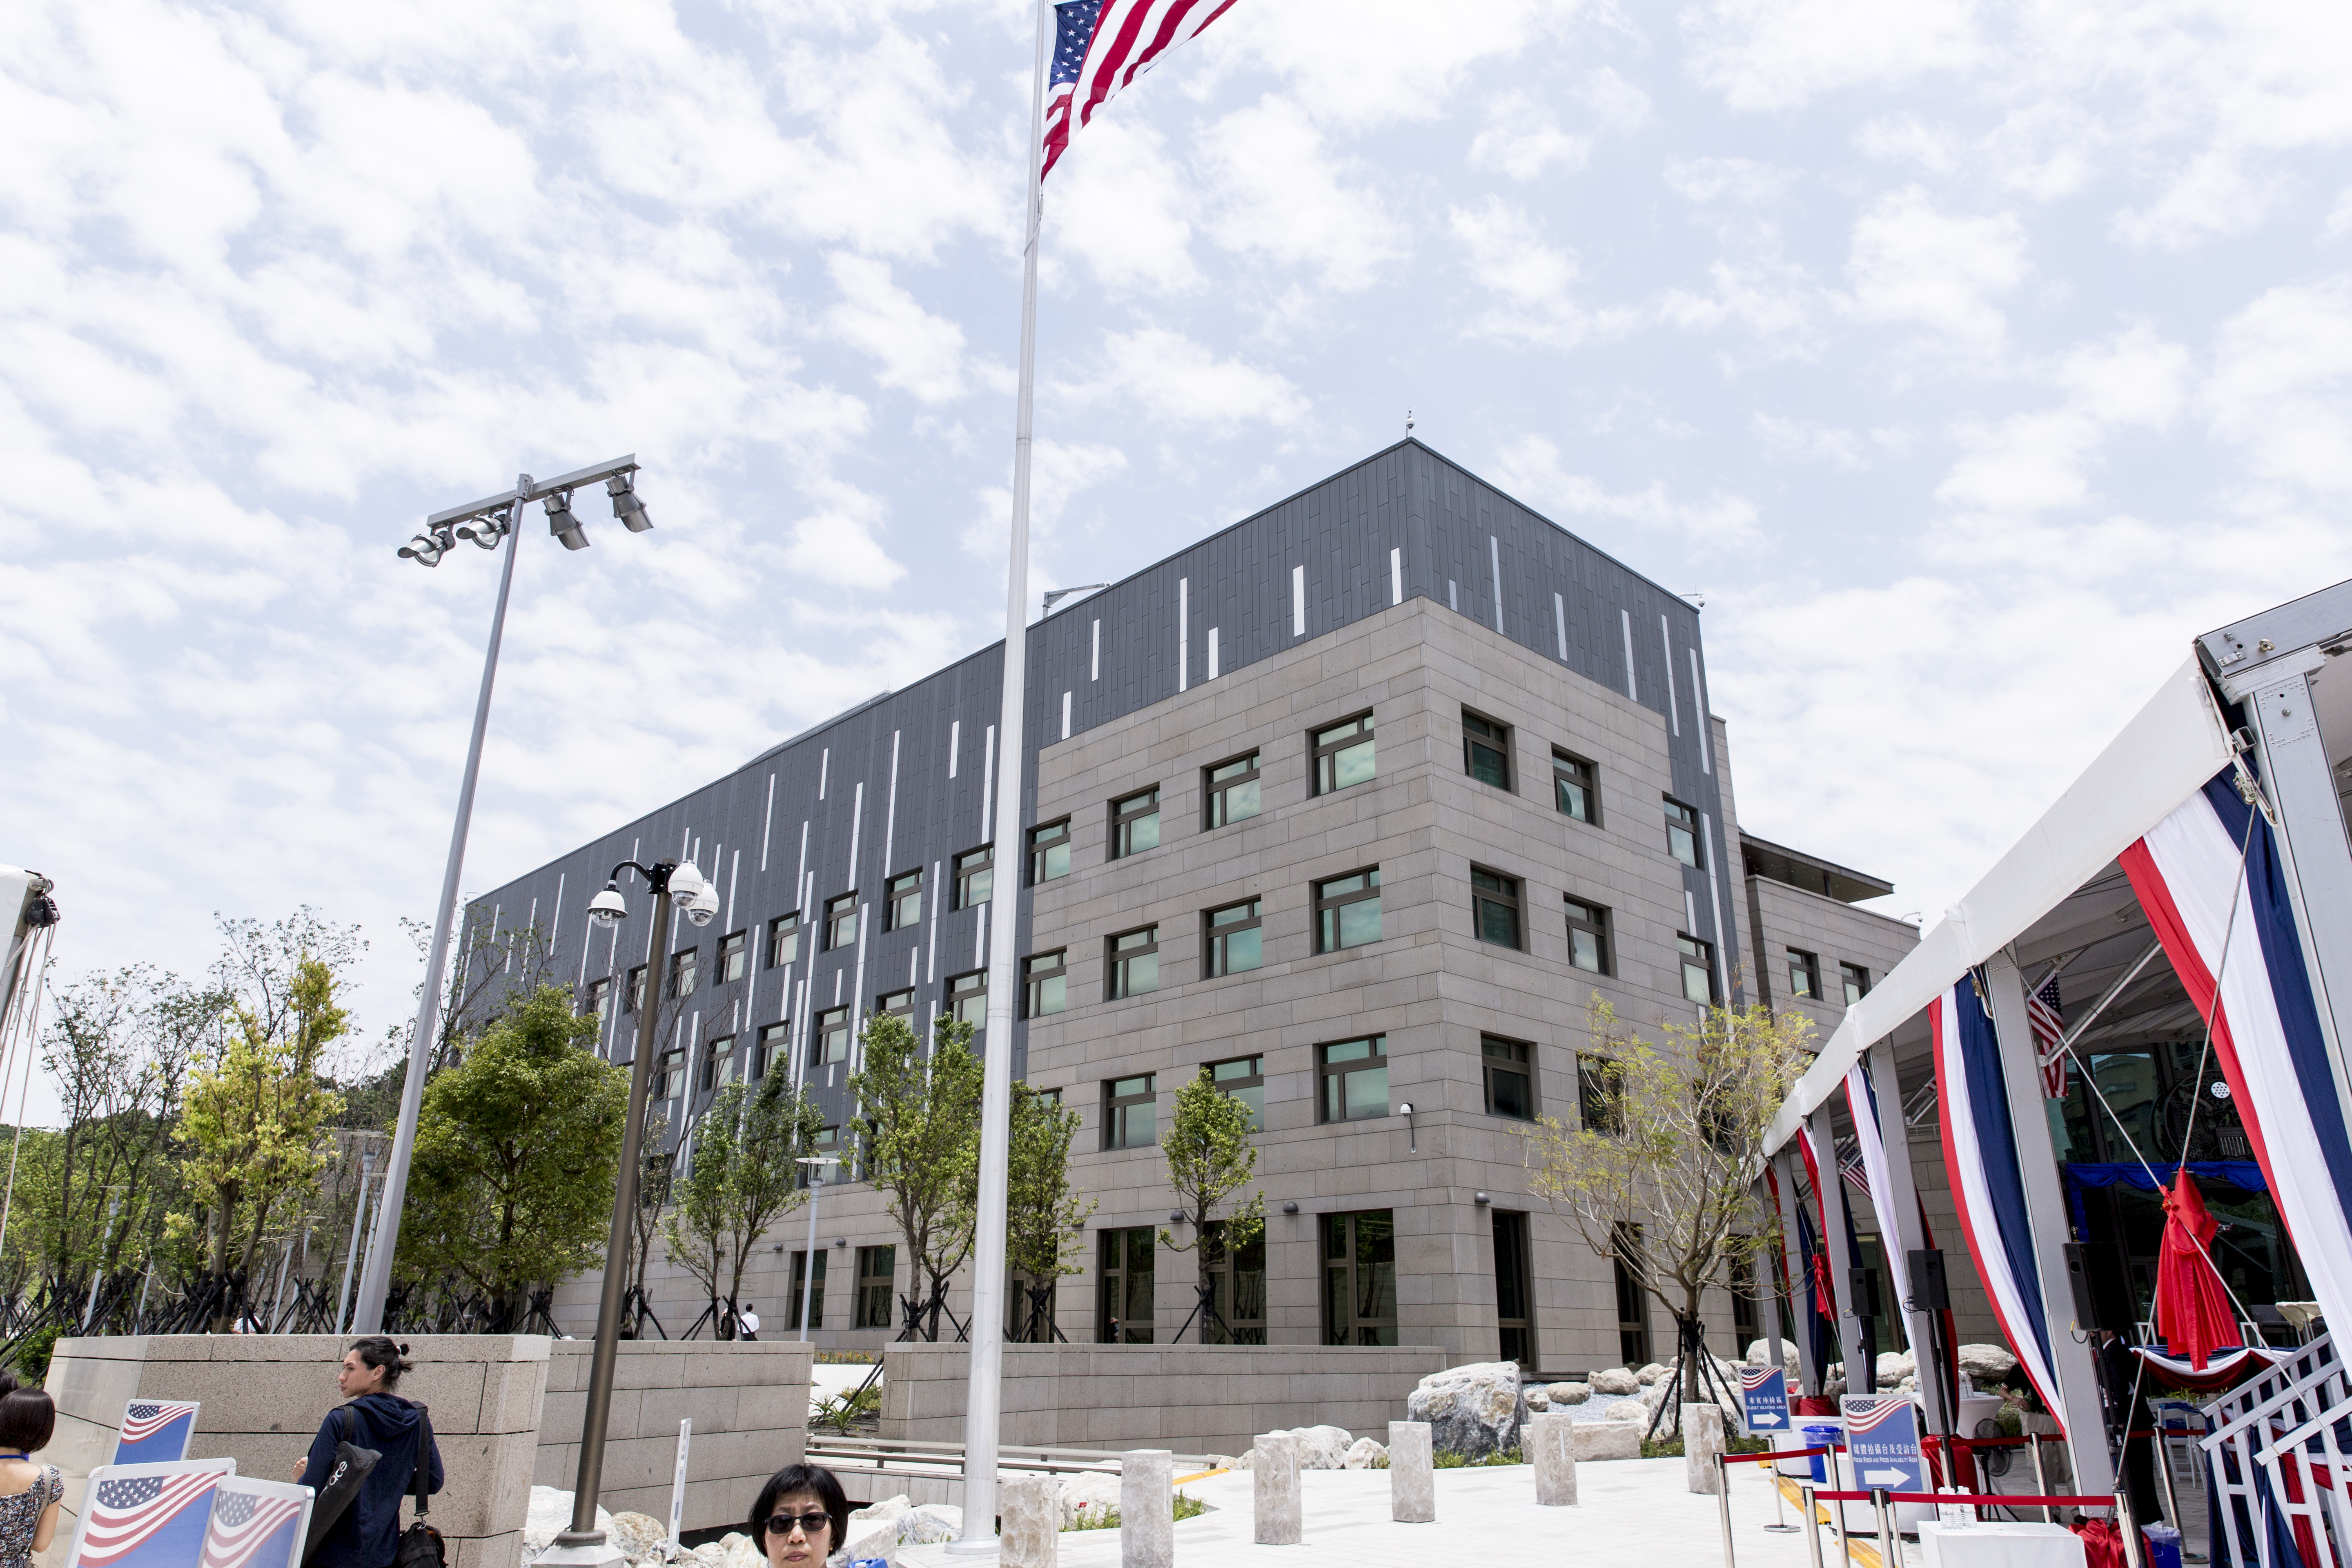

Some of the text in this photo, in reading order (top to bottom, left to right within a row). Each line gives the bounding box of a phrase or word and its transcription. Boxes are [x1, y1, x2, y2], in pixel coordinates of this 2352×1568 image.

[1853, 1443, 1917, 1454] 媒體拍攝台及受訪台
